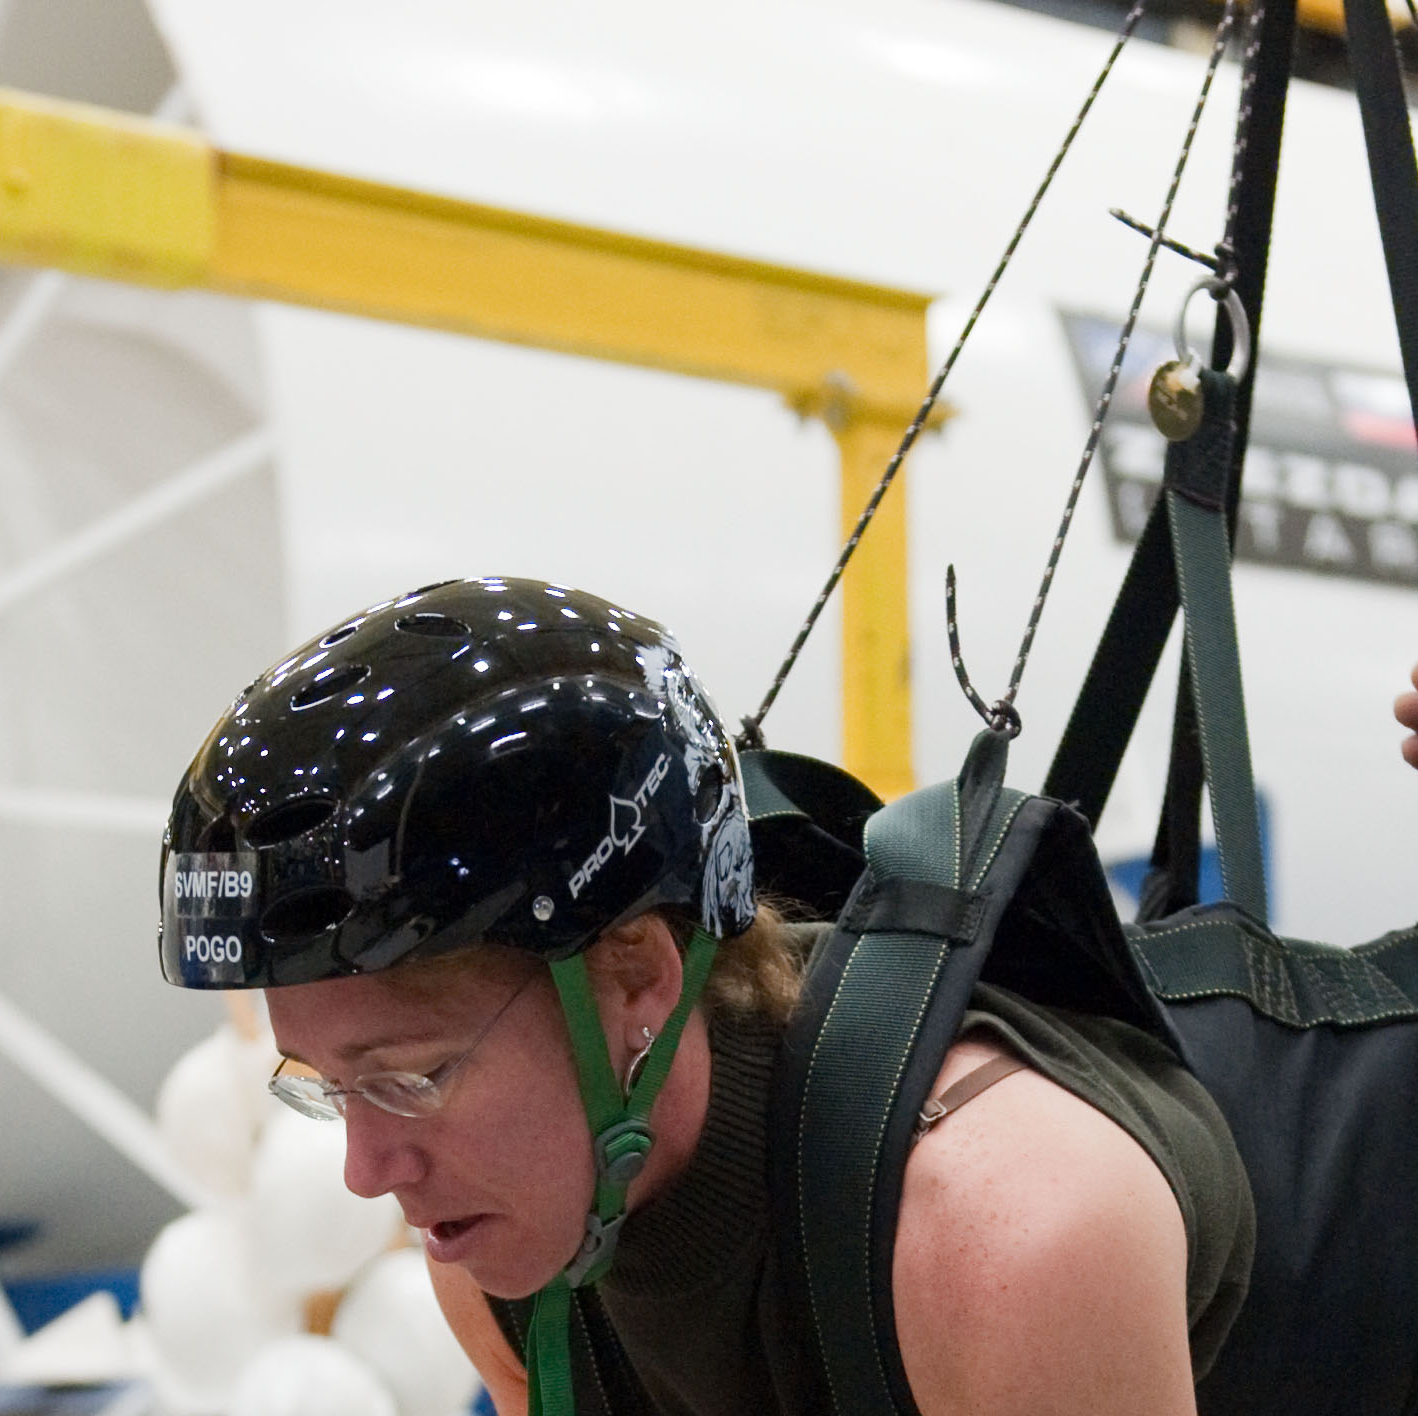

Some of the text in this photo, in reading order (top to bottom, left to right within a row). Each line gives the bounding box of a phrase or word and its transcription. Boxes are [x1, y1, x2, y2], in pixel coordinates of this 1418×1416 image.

[568, 752, 669, 899] PRO TEC
[175, 871, 252, 898] SVMF/B9
[186, 935, 242, 963] POGO
